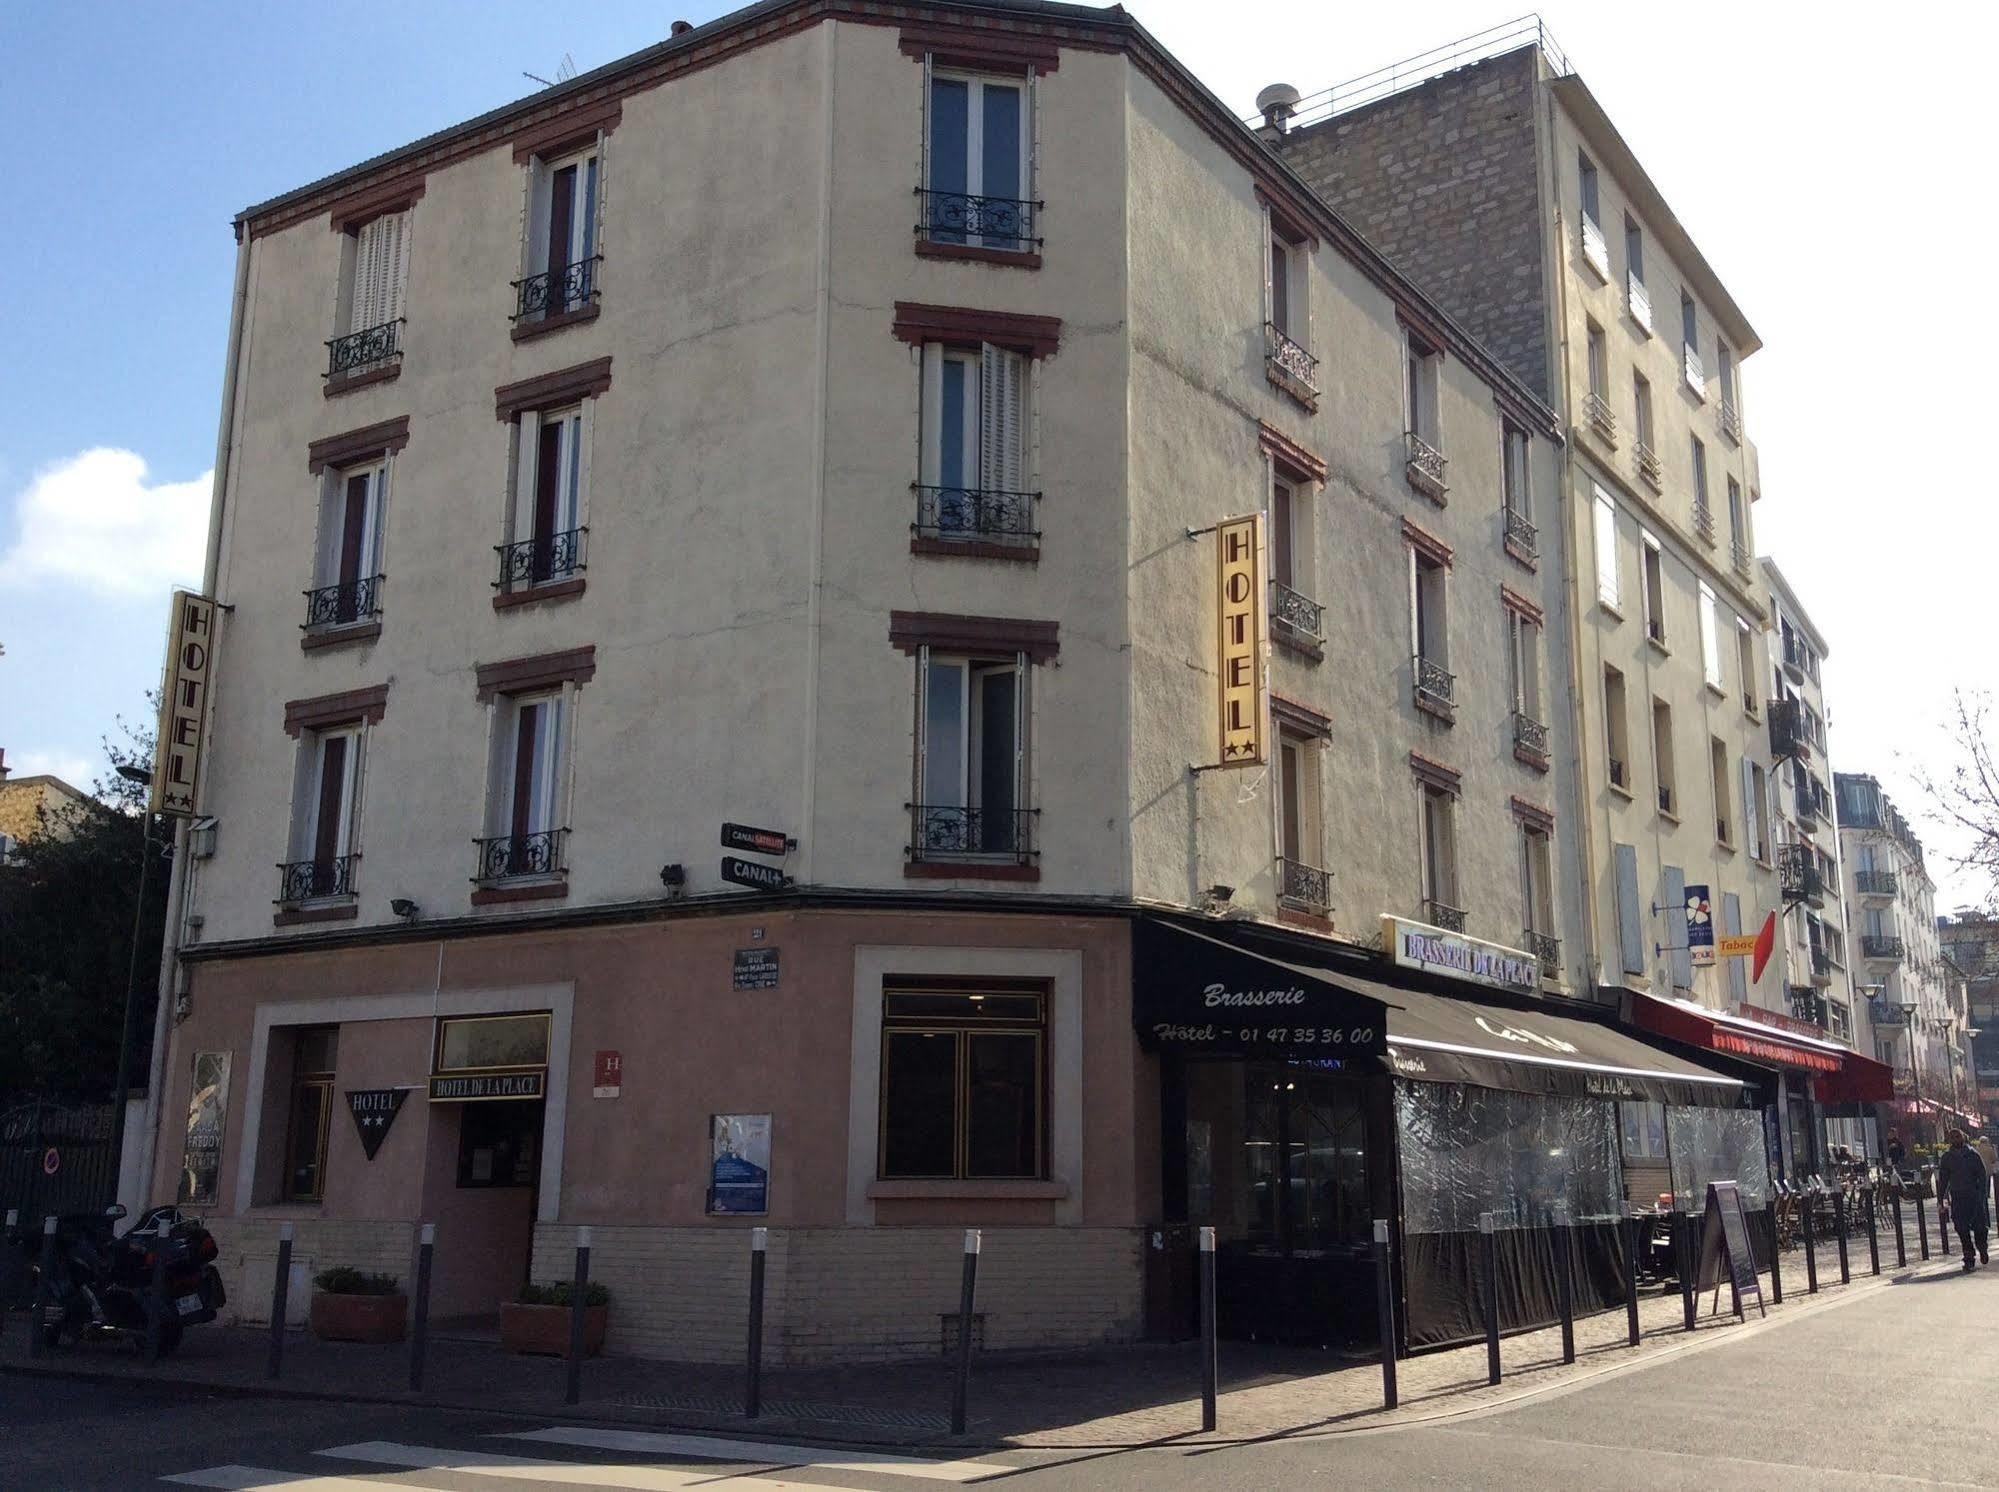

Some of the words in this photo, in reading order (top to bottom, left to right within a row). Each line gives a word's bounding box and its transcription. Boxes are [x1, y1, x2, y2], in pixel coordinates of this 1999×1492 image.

[1225, 530, 1252, 731] HOTEL
[169, 604, 209, 786] HOTEL
[734, 861, 782, 885] CANAL+
[750, 963, 777, 971] MARTIN
[1203, 982, 1306, 1008] Brasserie
[1153, 1023, 1216, 1041] Hôtel
[1239, 1028, 1258, 1042] 01
[1266, 1028, 1288, 1043] 47
[1293, 1028, 1316, 1043] 35
[1320, 1028, 1343, 1044] 36
[1350, 1027, 1374, 1044] 00
[607, 1056, 620, 1070] H
[437, 1079, 469, 1096] HOTEL
[471, 1079, 485, 1096] DE
[486, 1079, 501, 1095] LA
[503, 1077, 536, 1094] PLACE
[353, 1094, 394, 1111] HOTEL
